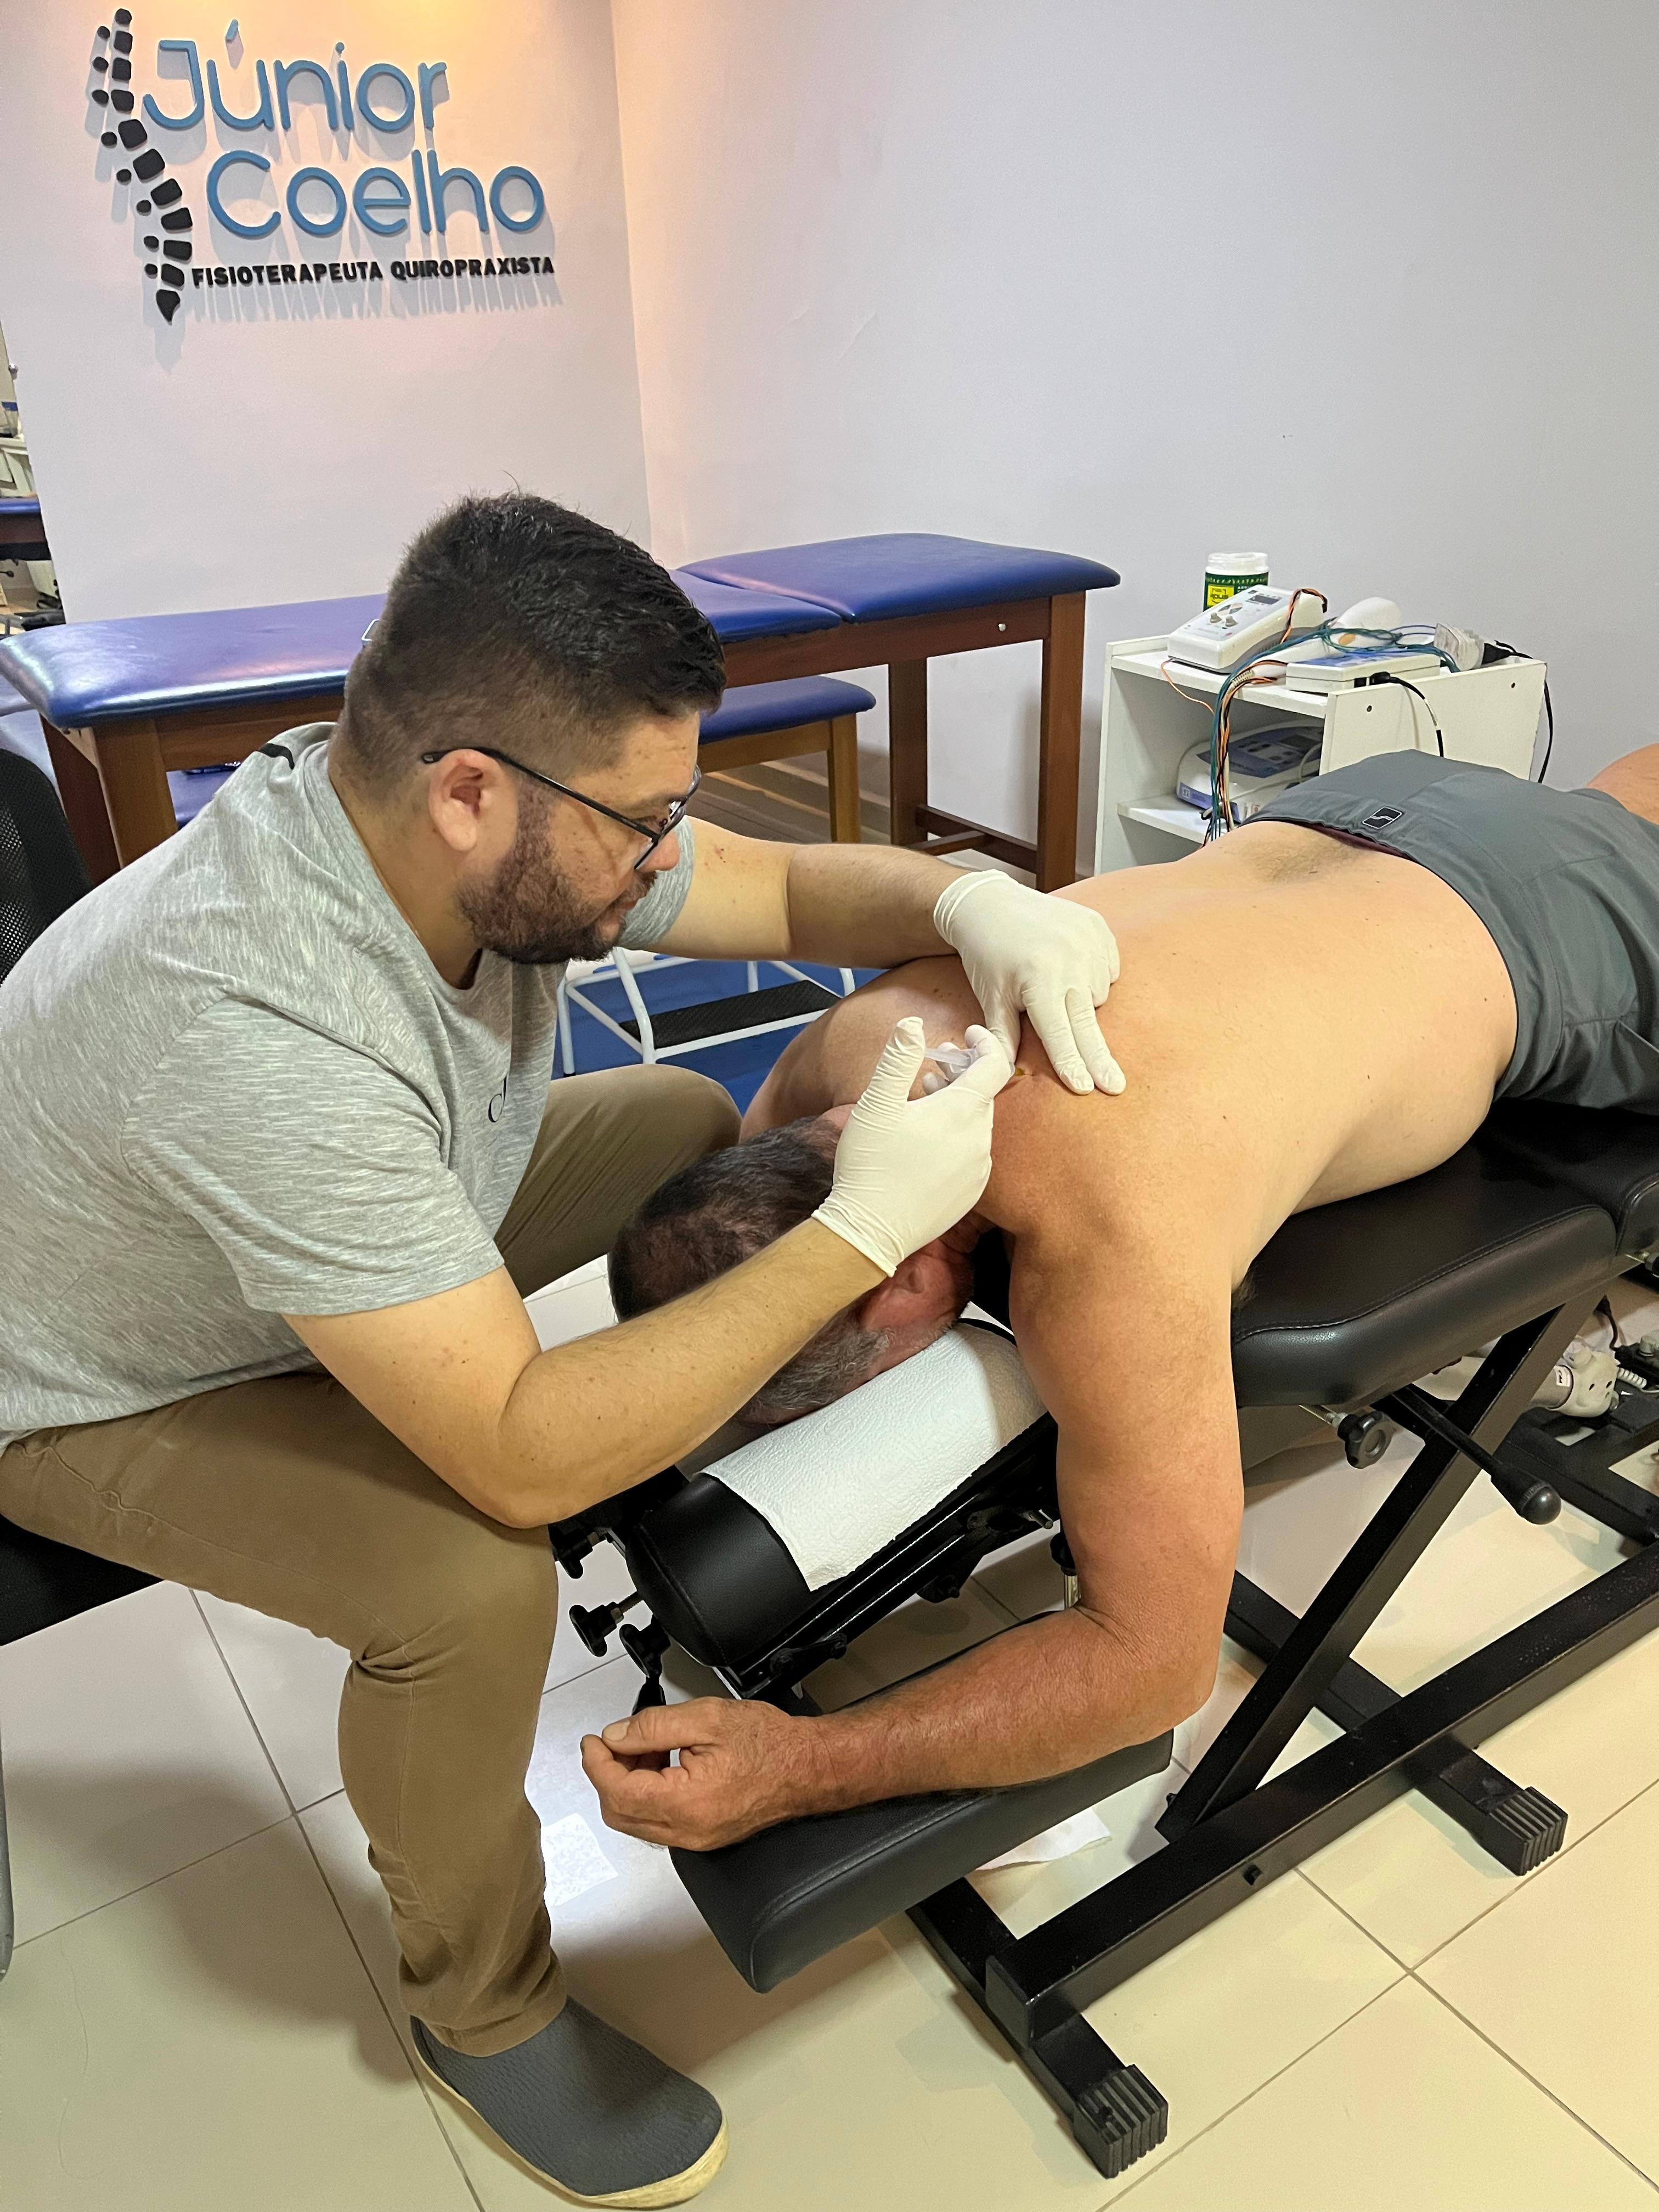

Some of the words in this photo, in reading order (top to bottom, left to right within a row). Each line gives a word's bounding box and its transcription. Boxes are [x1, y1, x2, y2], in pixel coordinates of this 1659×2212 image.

[142, 19, 447, 132] Júnior
[206, 149, 544, 238] Coelho
[191, 261, 383, 287] FISIOTERAPEUTA
[390, 256, 554, 281] QUIROPRAXISTA
